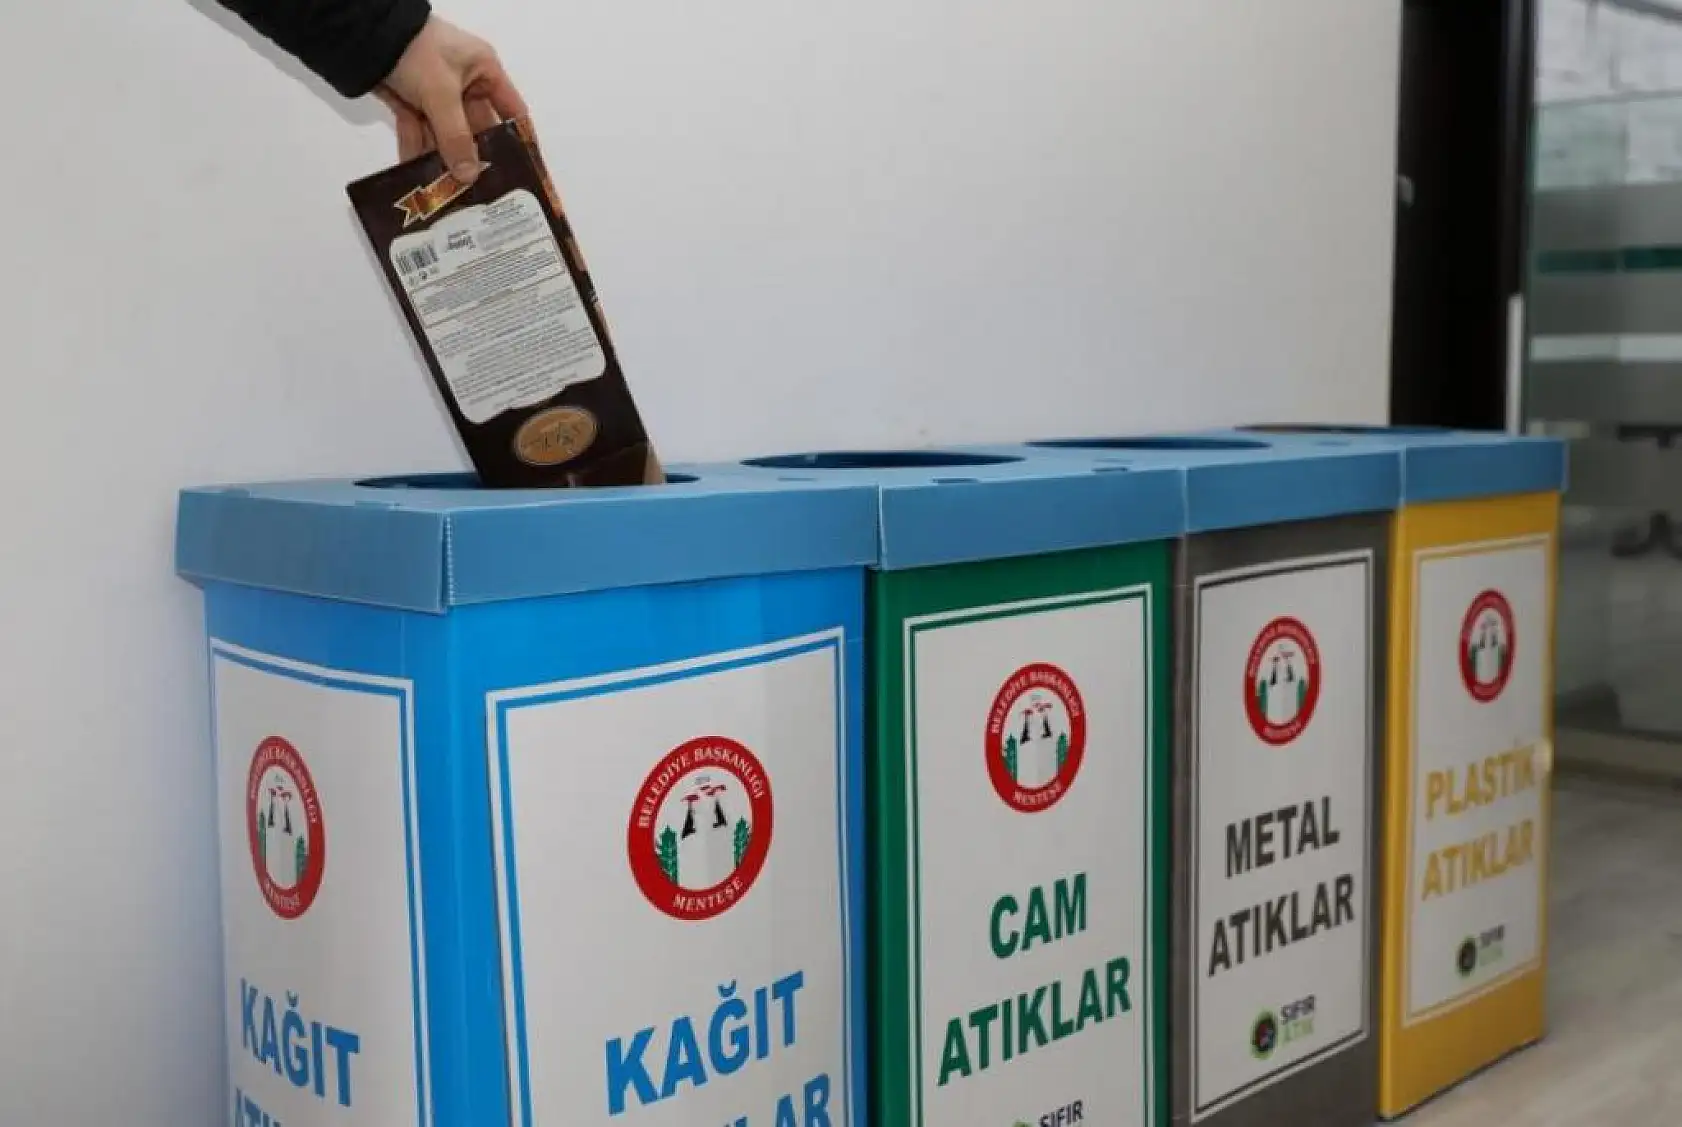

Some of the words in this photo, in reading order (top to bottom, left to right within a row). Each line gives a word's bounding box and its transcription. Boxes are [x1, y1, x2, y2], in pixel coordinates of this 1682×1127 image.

[1226, 796, 1340, 879] METAL
[1421, 818, 1534, 902] ATIKLAR
[989, 872, 1087, 959] CAM
[1208, 873, 1355, 977] ATIKLAR
[240, 977, 360, 1107] KAĞIT
[606, 970, 804, 1117] KAĞIT
[937, 956, 1132, 1087] ATIKLAR
[1038, 1099, 1084, 1127] SIFIR
